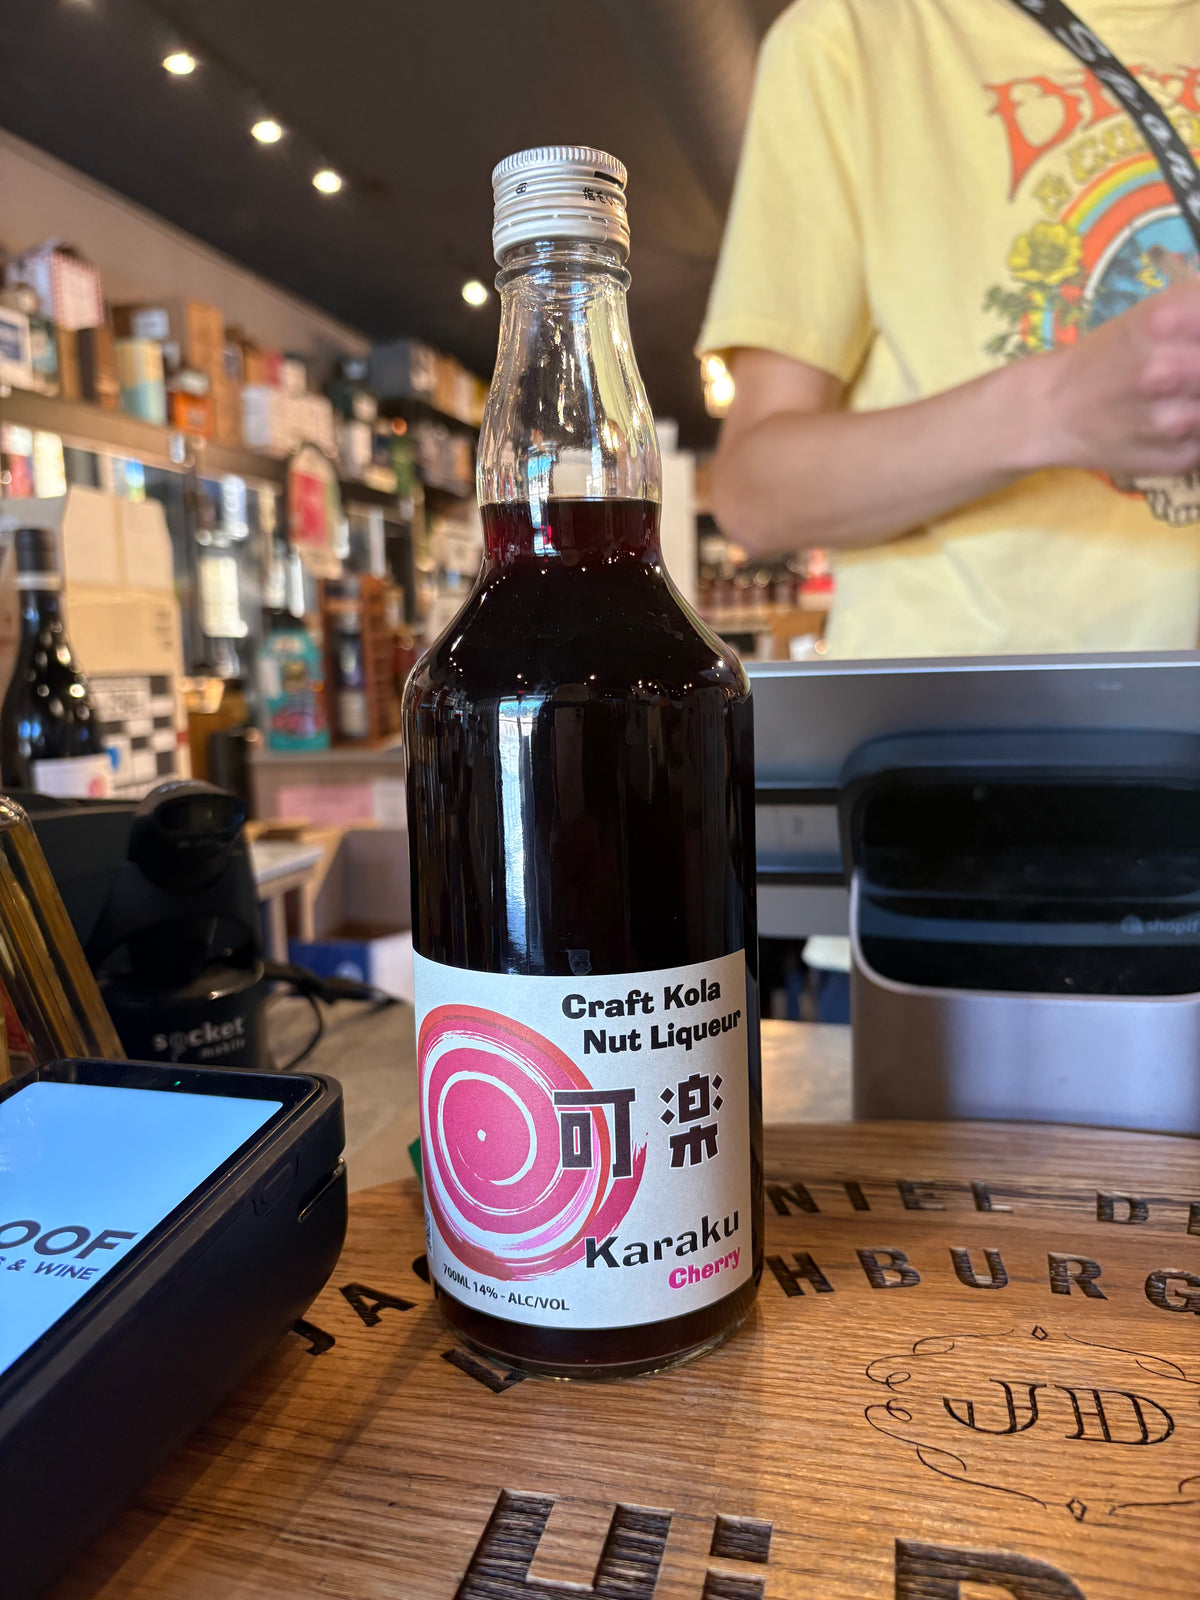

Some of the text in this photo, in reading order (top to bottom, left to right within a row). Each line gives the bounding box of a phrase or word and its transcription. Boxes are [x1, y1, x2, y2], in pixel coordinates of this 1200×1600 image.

[562, 978, 721, 1019] Craft Kola
[583, 1010, 741, 1055] Nut Liqueur
[585, 1210, 739, 1268] Karaku
[6, 1259, 27, 1272] &
[33, 1261, 100, 1280] WINE
[443, 1263, 471, 1290] 700ML
[473, 1281, 498, 1299] 14%
[508, 1292, 570, 1311] ALC/VOL
[669, 1246, 741, 1289] Cherry
[943, 1378, 1176, 1446] JD
